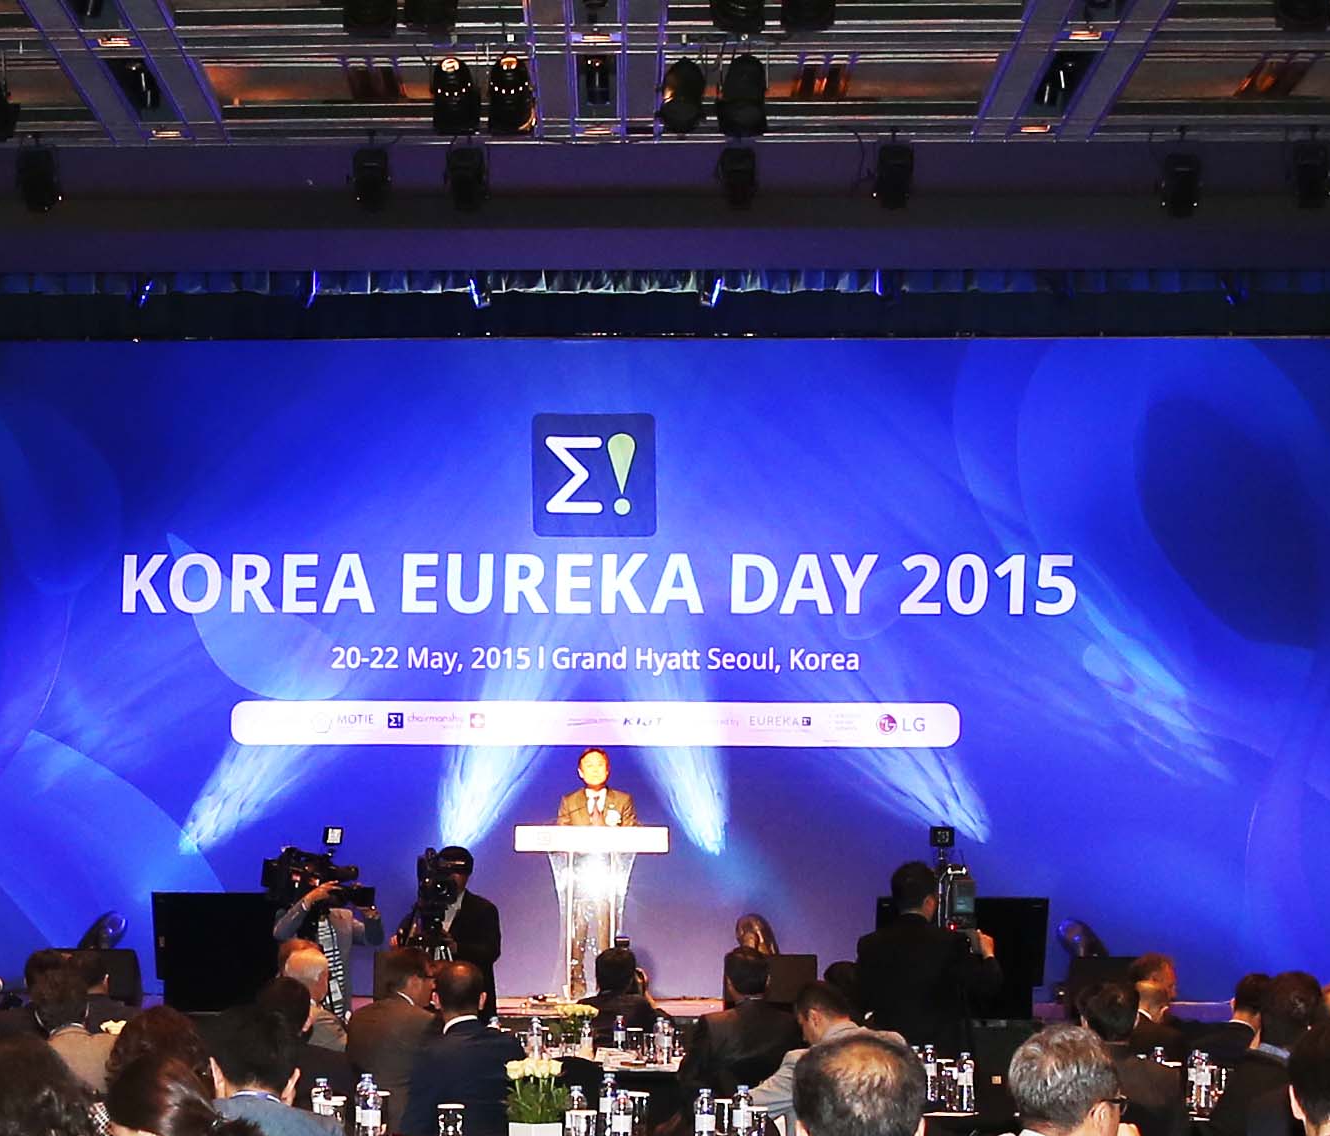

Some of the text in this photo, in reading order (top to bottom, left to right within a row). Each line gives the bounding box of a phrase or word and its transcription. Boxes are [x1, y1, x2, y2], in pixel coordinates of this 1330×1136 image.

[121, 552, 1078, 616] KOREA EUREKA DAY 2015
[331, 646, 399, 670] 20-22
[407, 647, 464, 676] May,
[470, 647, 531, 670] 2015
[552, 645, 627, 671] Grand
[635, 646, 701, 676] Hyatt
[707, 646, 781, 674] Seoul,
[789, 647, 860, 671] Korea
[337, 714, 374, 725] MOTIE
[749, 715, 800, 727] EUREKA
[902, 717, 926, 732] LG
